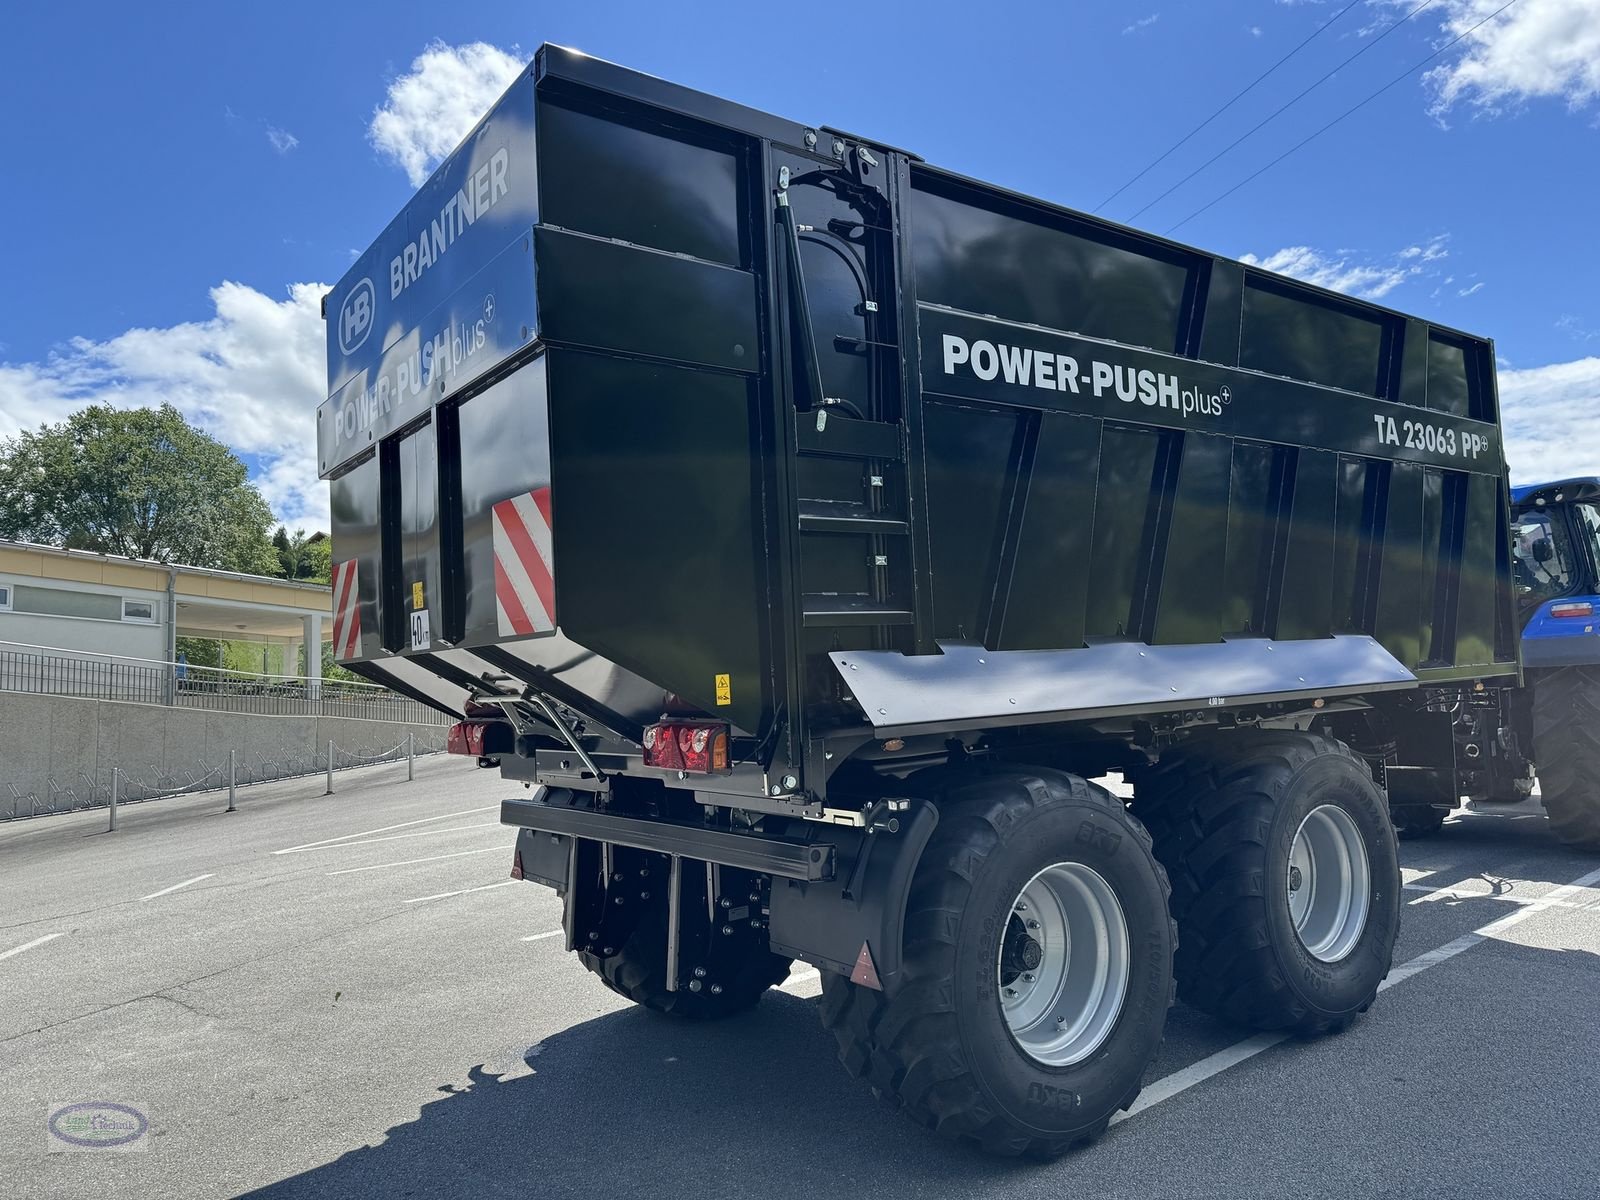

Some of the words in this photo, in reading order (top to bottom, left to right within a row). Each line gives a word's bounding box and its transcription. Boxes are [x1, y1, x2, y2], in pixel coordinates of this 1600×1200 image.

[390, 147, 510, 301] BRANTNER
[1374, 414, 1400, 446] TA
[1403, 420, 1457, 456] 23063
[412, 615, 423, 646] 40
